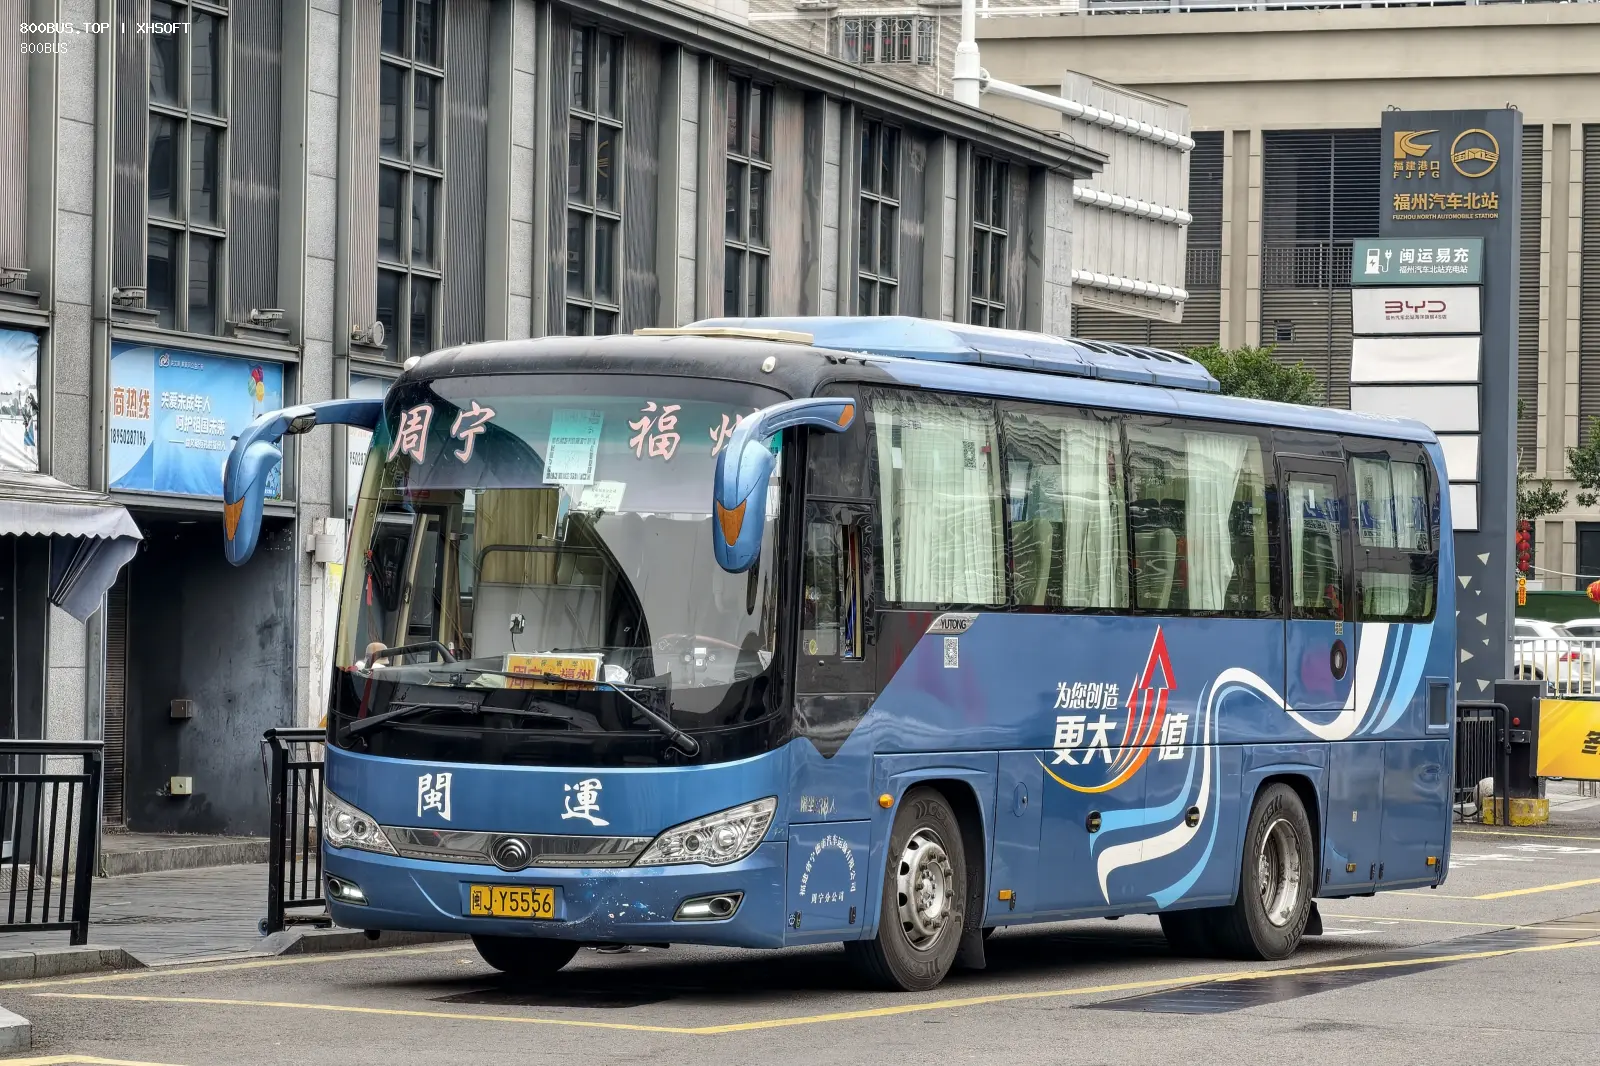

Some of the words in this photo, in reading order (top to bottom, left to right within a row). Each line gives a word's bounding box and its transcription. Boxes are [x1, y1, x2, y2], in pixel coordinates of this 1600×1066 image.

[1393, 160, 1440, 171] 福建港口
[1393, 191, 1499, 211] 福州汽车北站
[1399, 247, 1470, 264] 闽运易充
[1399, 265, 1469, 274] 福州汽车北站充电站
[1384, 300, 1447, 314] BYD
[111, 386, 150, 420] 商热线
[160, 391, 212, 414] 关爱未成年人
[175, 415, 226, 436] 呵护祖国未来
[387, 400, 497, 462] 周宁
[110, 427, 147, 446] 18950287196
[940, 618, 967, 630] YUTONG
[1053, 682, 1119, 710] 为您创造
[1050, 713, 1117, 766] 更大
[1158, 712, 1189, 762] 值
[811, 891, 845, 904] 周宁分公司
